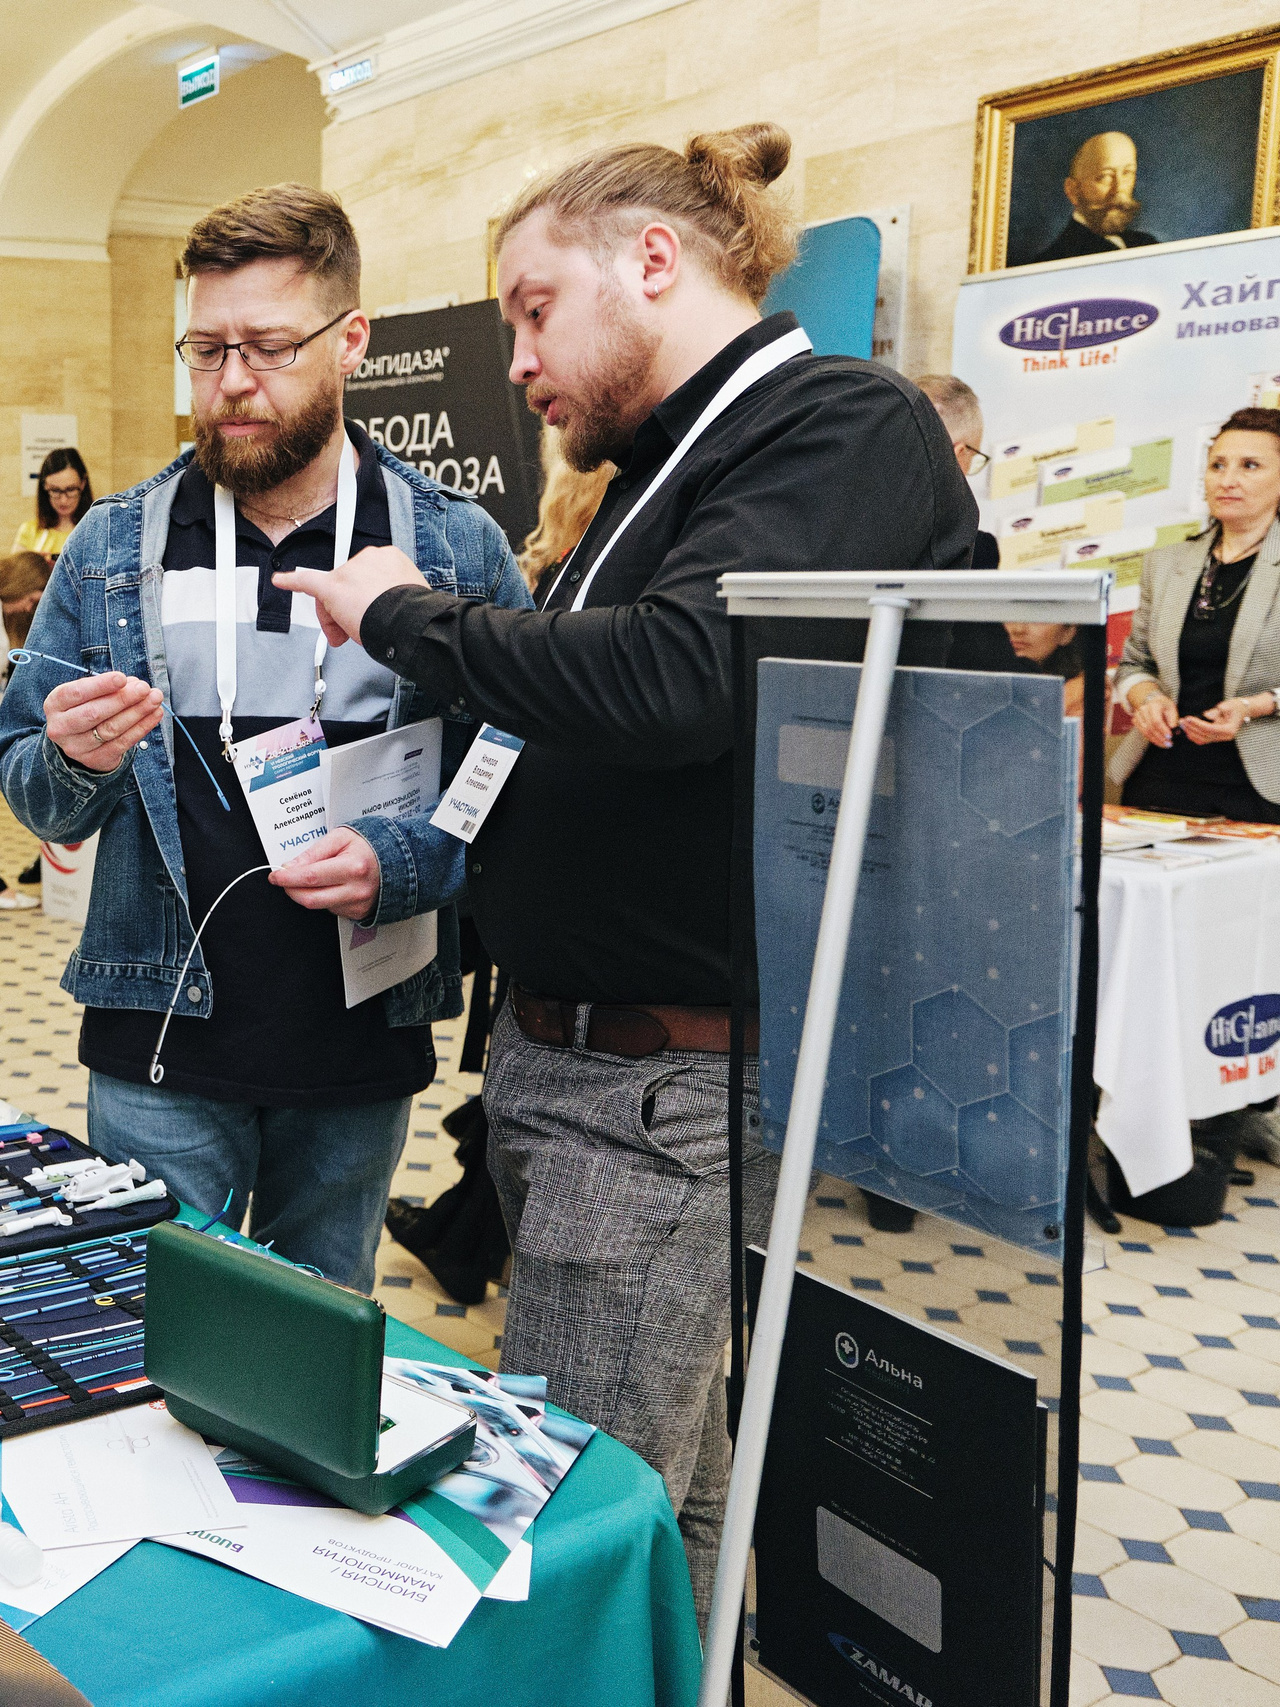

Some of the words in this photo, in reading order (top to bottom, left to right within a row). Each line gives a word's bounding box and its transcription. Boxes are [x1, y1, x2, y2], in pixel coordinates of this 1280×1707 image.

[182, 69, 215, 97] ВЫХОД
[1012, 307, 1149, 350] HiGlance
[1022, 352, 1069, 372] Think
[1079, 346, 1118, 367] Life!
[404, 455, 505, 496] РОЗА
[279, 788, 312, 805] Семёнов
[286, 798, 313, 814] Сергей
[361, 803, 382, 816] ФОРУМ
[448, 797, 480, 819] УЧАСТНИК
[865, 1349, 923, 1390] Альна
[327, 1538, 391, 1563] ПРОДУКТОВ
[312, 1545, 436, 1593] МАММОЛОГИЯ
[393, 1561, 444, 1580] КАТАЛОГ
[341, 1569, 428, 1603] БИОПСИЯ
